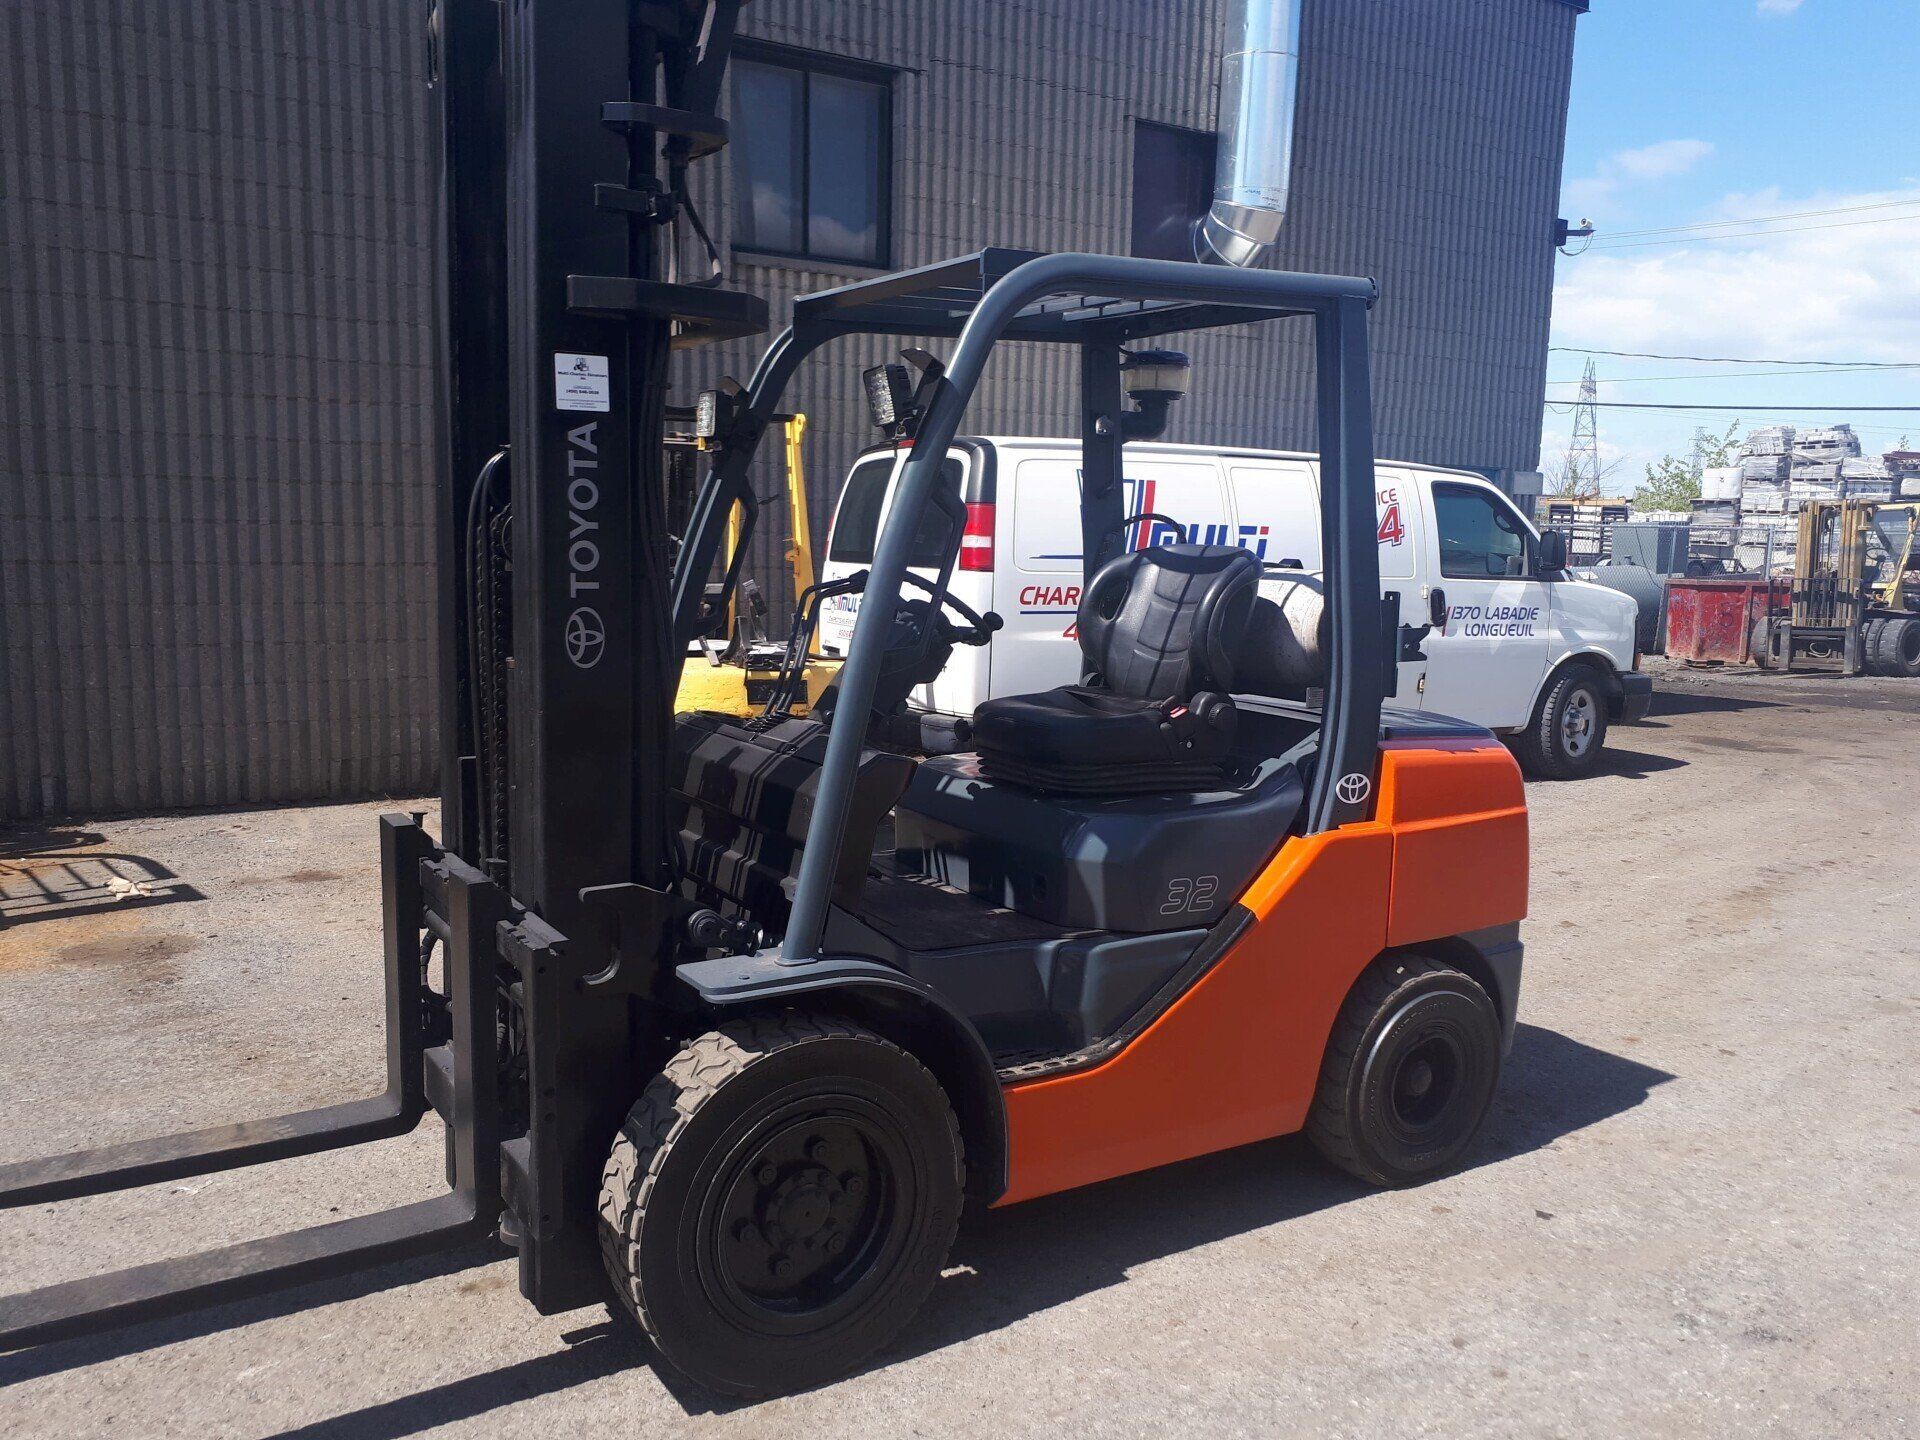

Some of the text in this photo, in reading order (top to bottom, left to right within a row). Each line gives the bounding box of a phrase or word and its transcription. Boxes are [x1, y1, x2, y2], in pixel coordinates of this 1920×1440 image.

[568, 421, 600, 598] TOYOTA
[1019, 586, 1081, 606] CHAR
[1450, 606, 1540, 621] 1370 LABADIE
[1464, 623, 1535, 637] LONGUEUIL
[1160, 875, 1219, 915] 32
